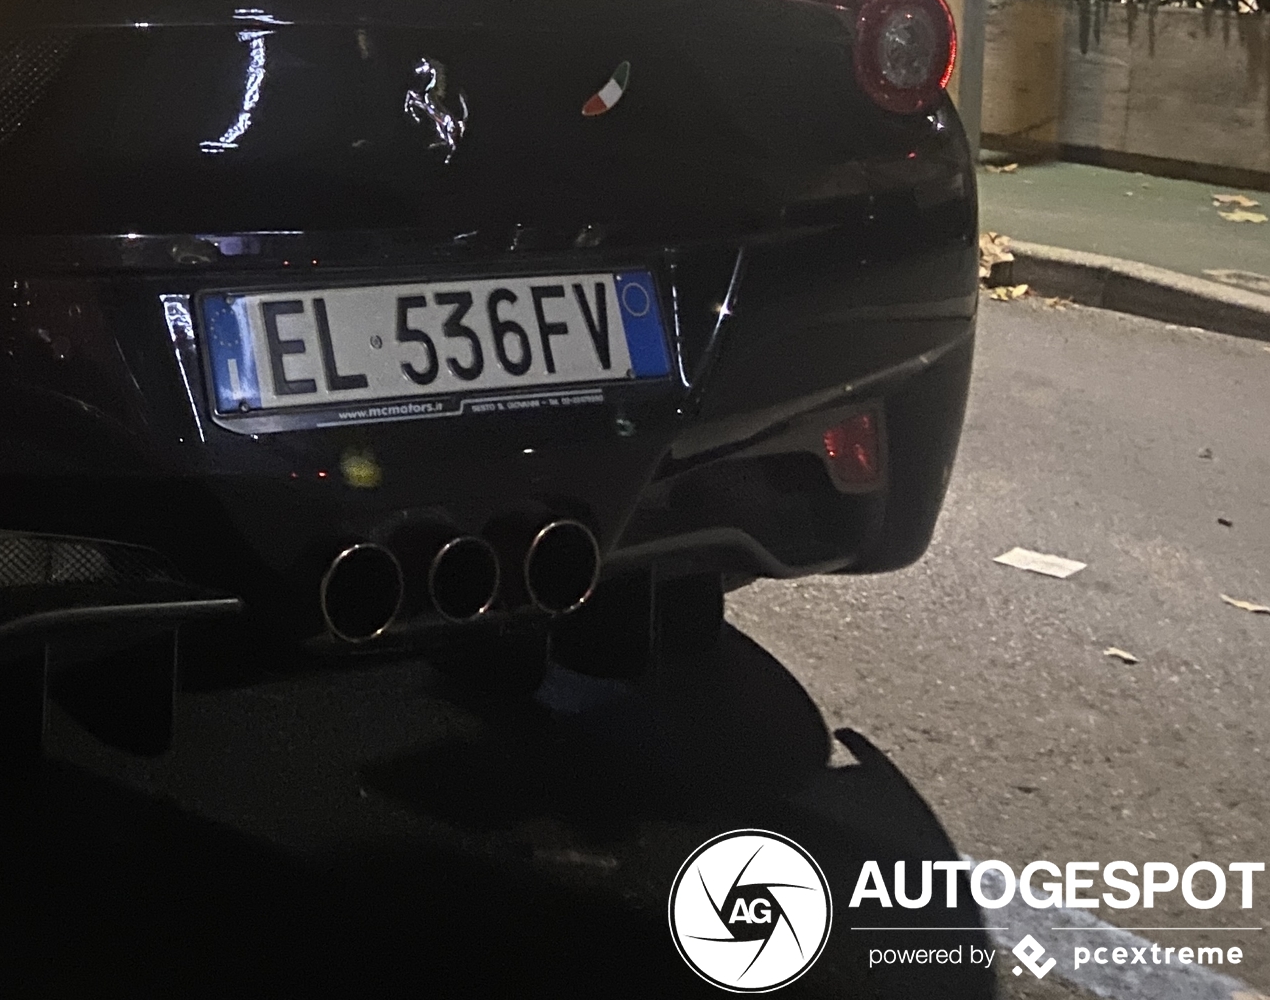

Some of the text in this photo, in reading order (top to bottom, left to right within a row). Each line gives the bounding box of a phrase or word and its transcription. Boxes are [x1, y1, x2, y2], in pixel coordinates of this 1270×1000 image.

[259, 282, 613, 397] EL 536FV
[338, 401, 444, 420] www.mcmotors.it
